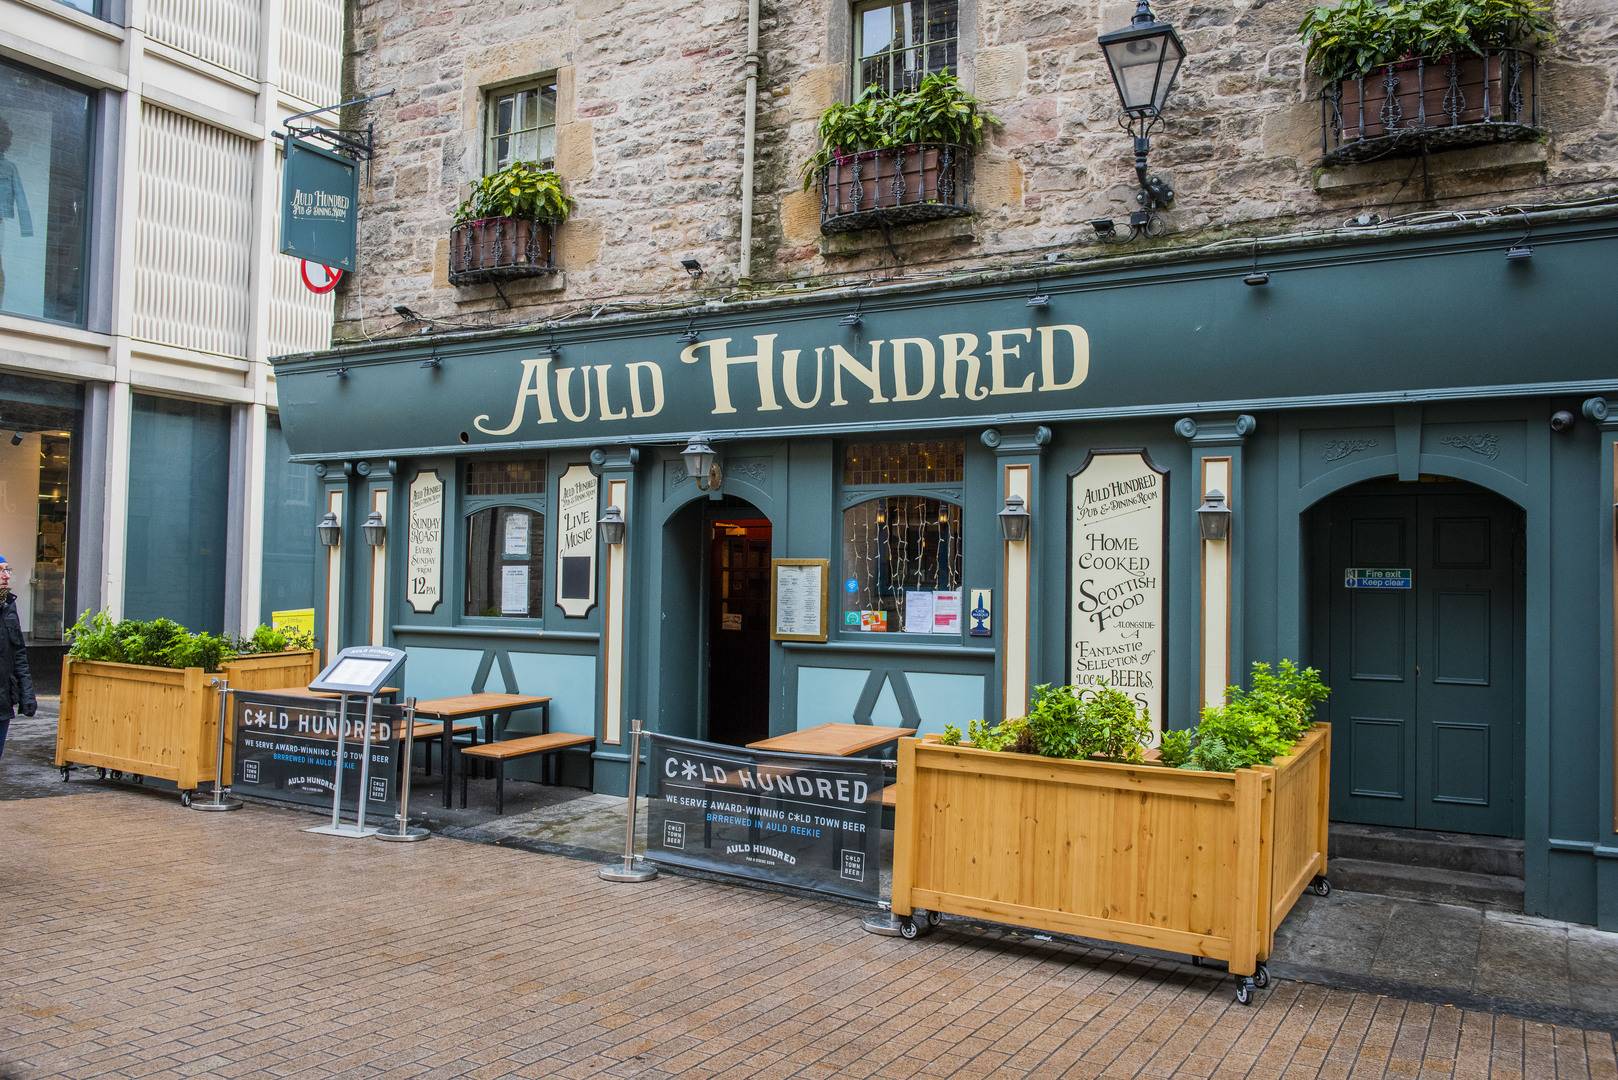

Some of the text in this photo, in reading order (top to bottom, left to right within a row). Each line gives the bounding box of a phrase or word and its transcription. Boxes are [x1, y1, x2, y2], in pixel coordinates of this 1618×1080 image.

[290, 189, 350, 209] AULD HUNDRED
[473, 323, 1090, 436] AULD HUNDRED
[1077, 474, 1156, 510] AULD HUNDRED
[1077, 491, 1158, 521] PUB & DINING ROOM
[411, 511, 440, 530] SUNDAY
[564, 510, 590, 532] LIVE
[410, 529, 439, 544] ROAST
[561, 528, 592, 555] MUSIC
[1086, 533, 1139, 551] HOME
[411, 555, 435, 566] SUNDAY
[415, 546, 433, 555] EVERY
[1079, 552, 1150, 576] COOKED
[1366, 570, 1402, 578] Fire exit
[1362, 579, 1382, 587] Keep
[1078, 577, 1156, 613] SCOTTISH
[1090, 593, 1145, 632] FOOD
[1113, 621, 1155, 629] ALONGSIDE
[1076, 641, 1143, 657] FANTASTIC
[1077, 650, 1156, 671] SELECTION of
[245, 739, 254, 747] WE
[255, 741, 274, 750] SERVE
[275, 743, 329, 756] AWARD-WINNING
[372, 754, 389, 764] BEER
[307, 756, 314, 764] IN
[315, 757, 332, 767] AULD
[288, 776, 305, 786] AULD
[738, 769, 868, 804] HUNDRED
[666, 794, 678, 804] WE
[680, 797, 707, 809] SERVE
[710, 801, 785, 820] AWARD-WINNING
[814, 816, 840, 829] TOWN
[842, 821, 866, 833] BEER
[668, 831, 682, 839] TOWN
[706, 813, 821, 838] BRRREWED IN AULD REEKIE
[726, 844, 796, 865] AULD HUNDRED
[844, 868, 860, 876] BEER
[845, 861, 861, 869] TOWN
